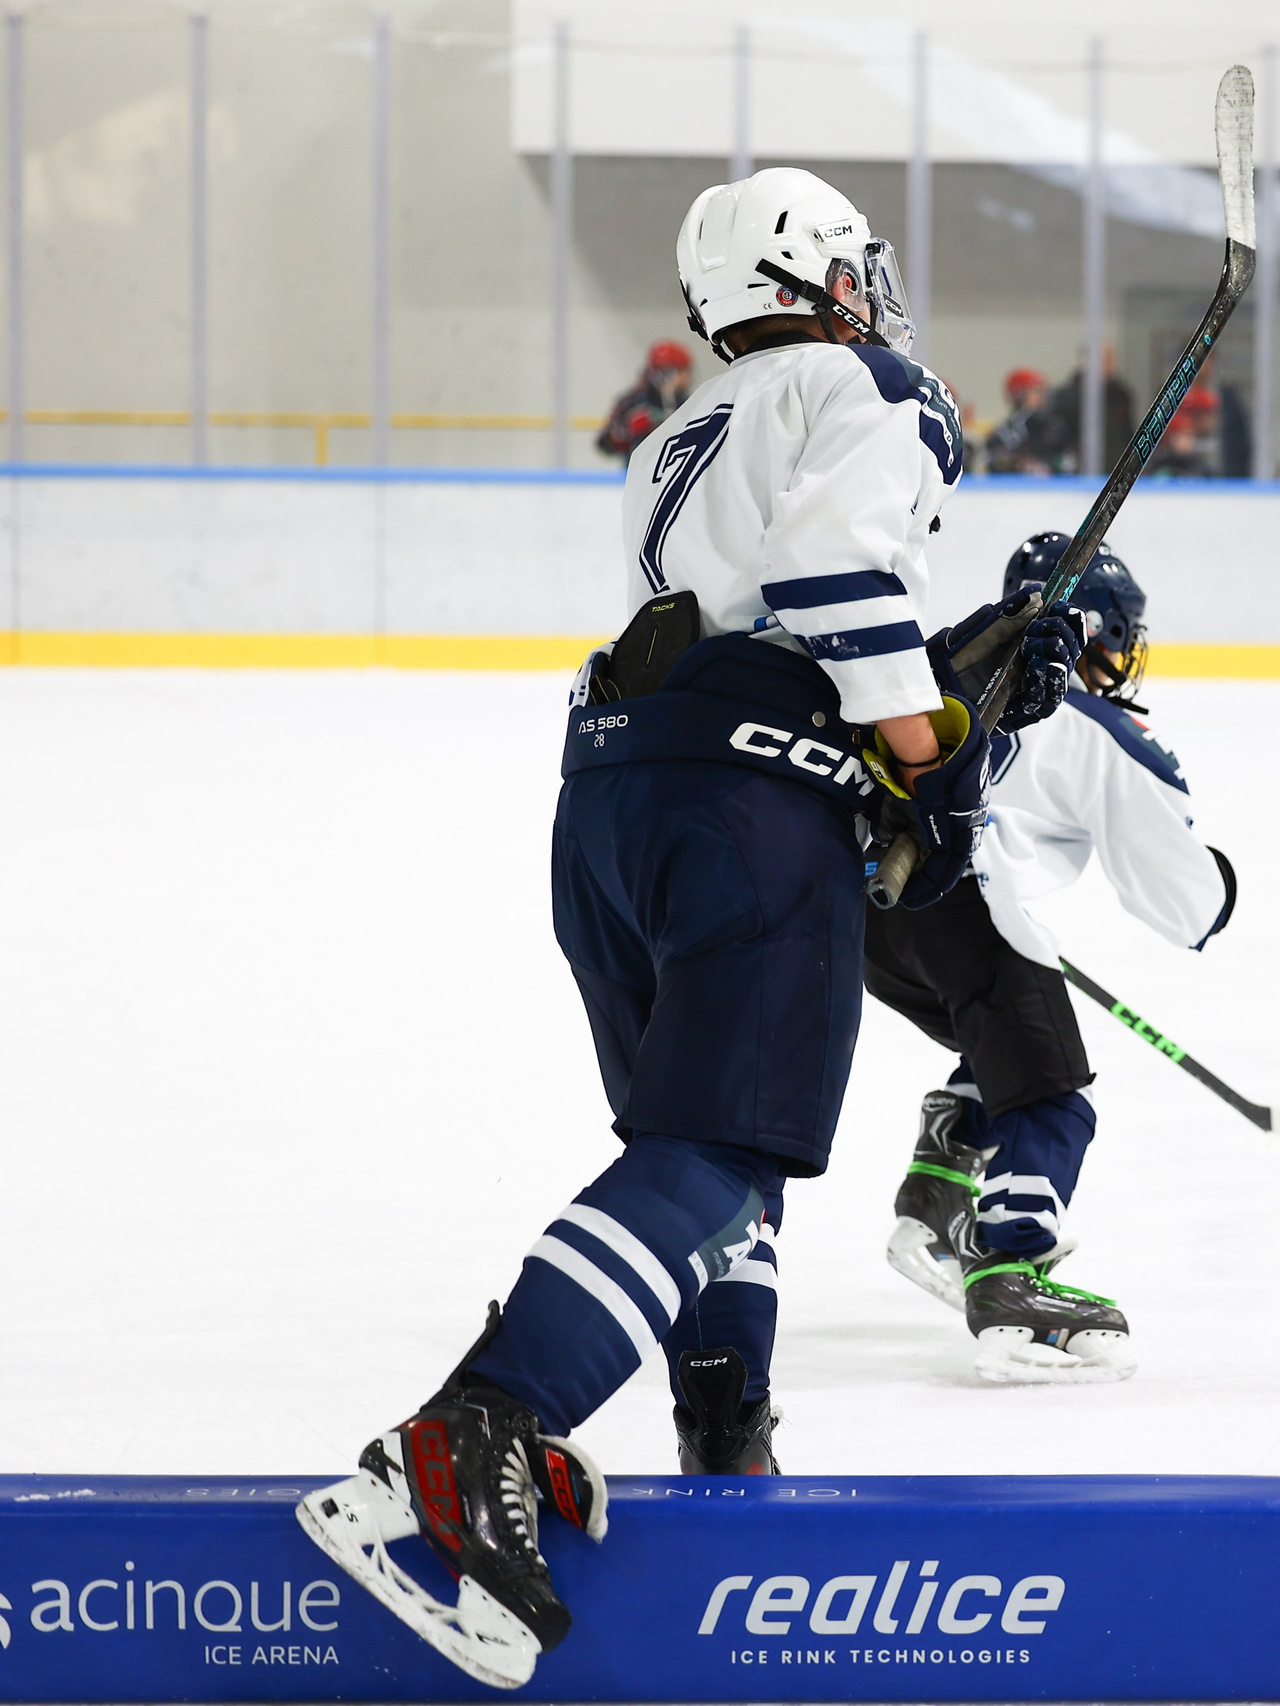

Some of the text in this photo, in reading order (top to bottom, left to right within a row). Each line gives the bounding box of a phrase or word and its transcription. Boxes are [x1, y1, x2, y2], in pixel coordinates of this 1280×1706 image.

[824, 225, 853, 238] CCM
[832, 304, 870, 334] CCM
[639, 403, 734, 595] 7
[651, 602, 676, 613] TACKS
[578, 714, 629, 734] AS 580
[593, 733, 605, 747] 28
[729, 722, 875, 797] CCM
[1110, 1001, 1187, 1064] CCM
[690, 1356, 728, 1368] CCM
[420, 1428, 457, 1535] CCM
[632, 1488, 857, 1497] ICE RINK
[30, 1560, 341, 1632] acinque
[697, 1560, 1066, 1635] realice
[205, 1645, 339, 1665] ICE ARENA
[731, 1648, 1031, 1665] ICE RINK TECHNOLOGIES
